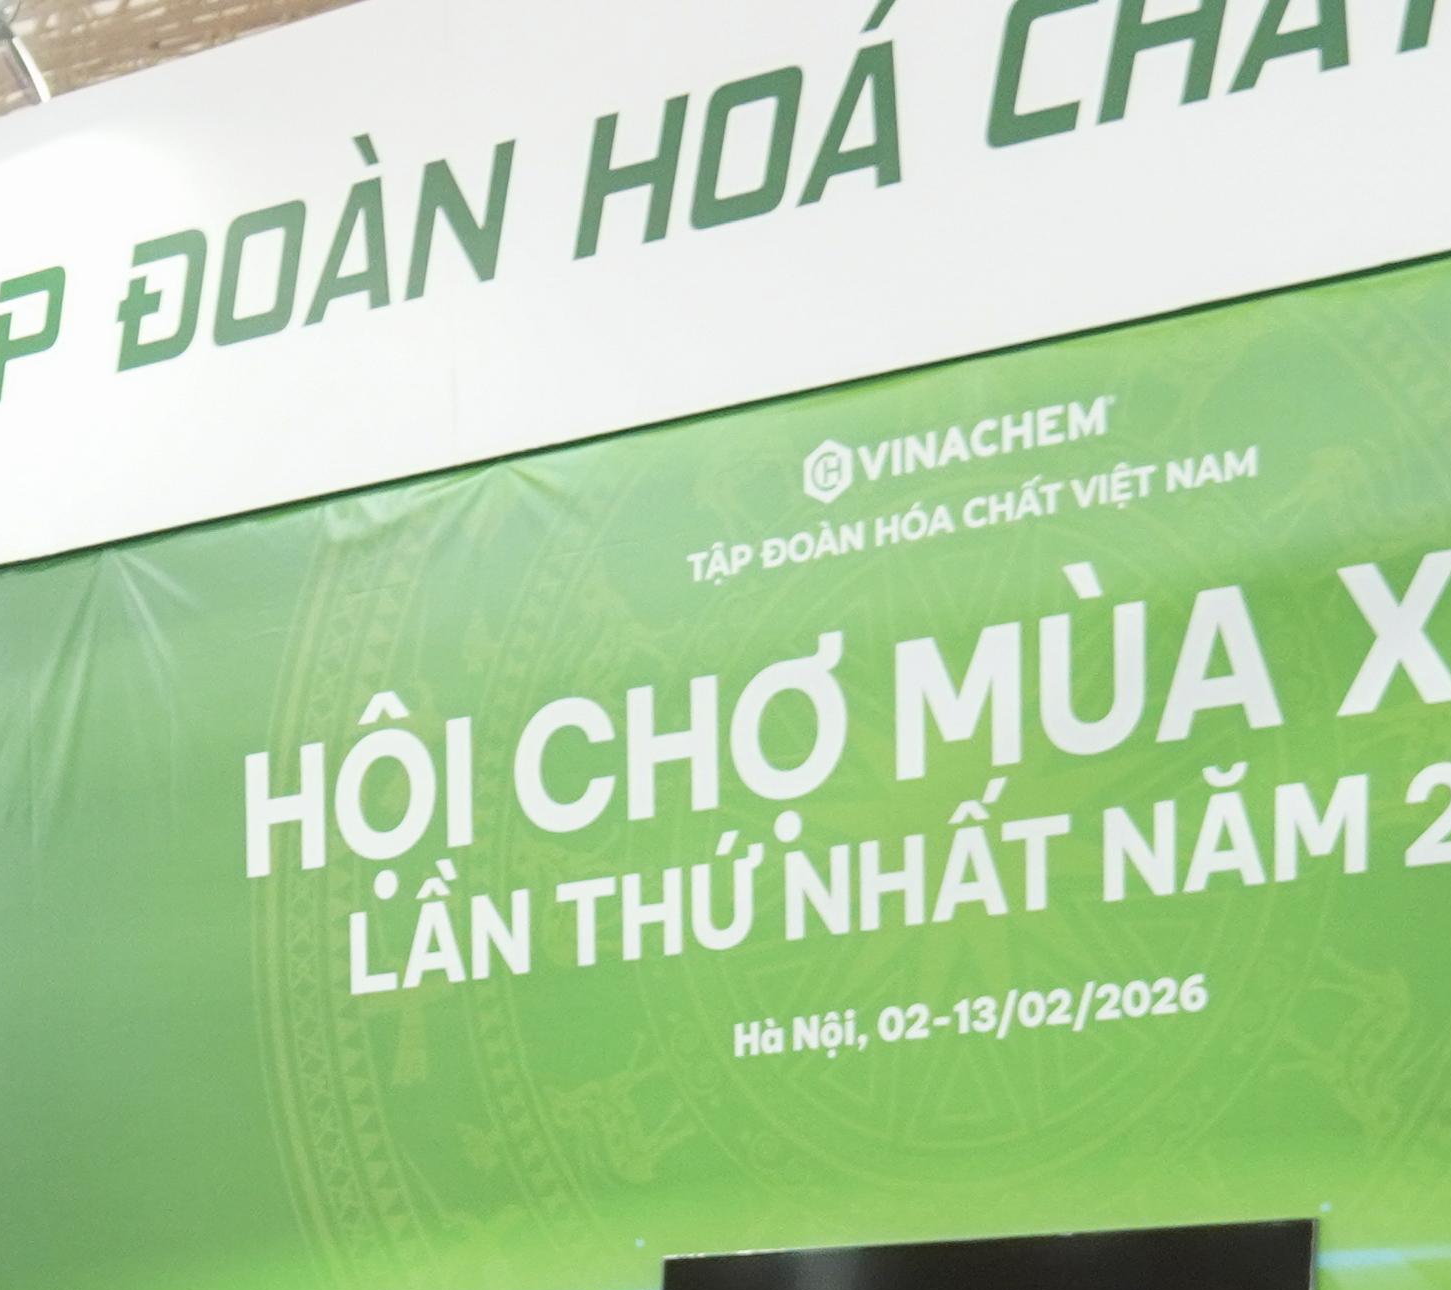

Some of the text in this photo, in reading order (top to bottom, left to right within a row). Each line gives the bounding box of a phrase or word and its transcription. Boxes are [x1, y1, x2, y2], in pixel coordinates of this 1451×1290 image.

[116, 132, 515, 372] ĐOÀN
[573, 0, 902, 260] HOÁ
[687, 445, 1259, 586] TẬP ĐOÀN HÓA CHẤT VIỆT NAM
[857, 395, 1108, 481] VINACHEM
[244, 691, 473, 902] HỘI
[514, 631, 846, 842] CHỢ
[895, 563, 1283, 781] MÙA
[348, 860, 531, 995] LẦN
[555, 830, 764, 968] THỨ
[780, 777, 1072, 941] NHẤT
[1099, 760, 1370, 902] NĂM
[734, 975, 1208, 1058] Hà Nội, 02-13/02/2026
